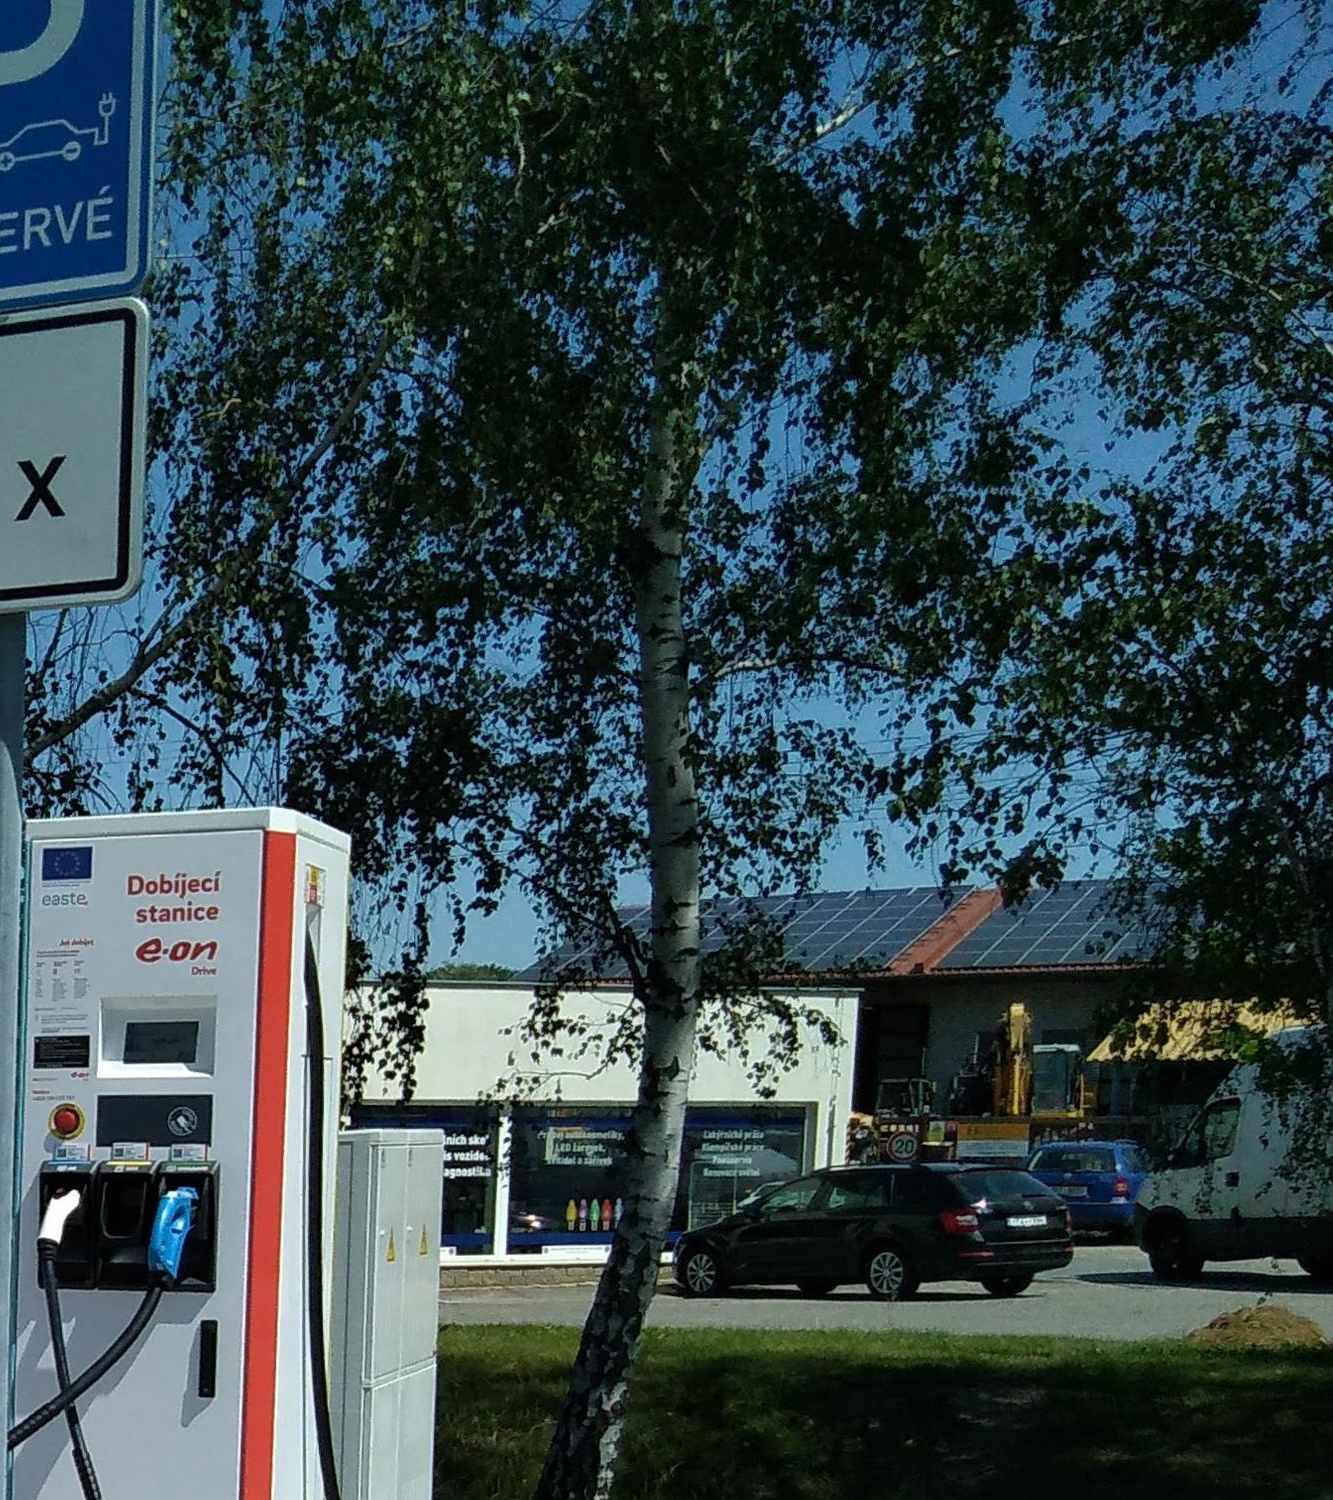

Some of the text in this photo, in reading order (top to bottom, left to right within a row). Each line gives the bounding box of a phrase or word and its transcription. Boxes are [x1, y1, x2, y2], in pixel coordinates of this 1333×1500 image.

[128, 871, 221, 899] Dobíjecí
[136, 901, 219, 923] stanice
[191, 966, 217, 975] Drive
[895, 1138, 915, 1154] 20
[443, 1166, 492, 1179] agnostika
